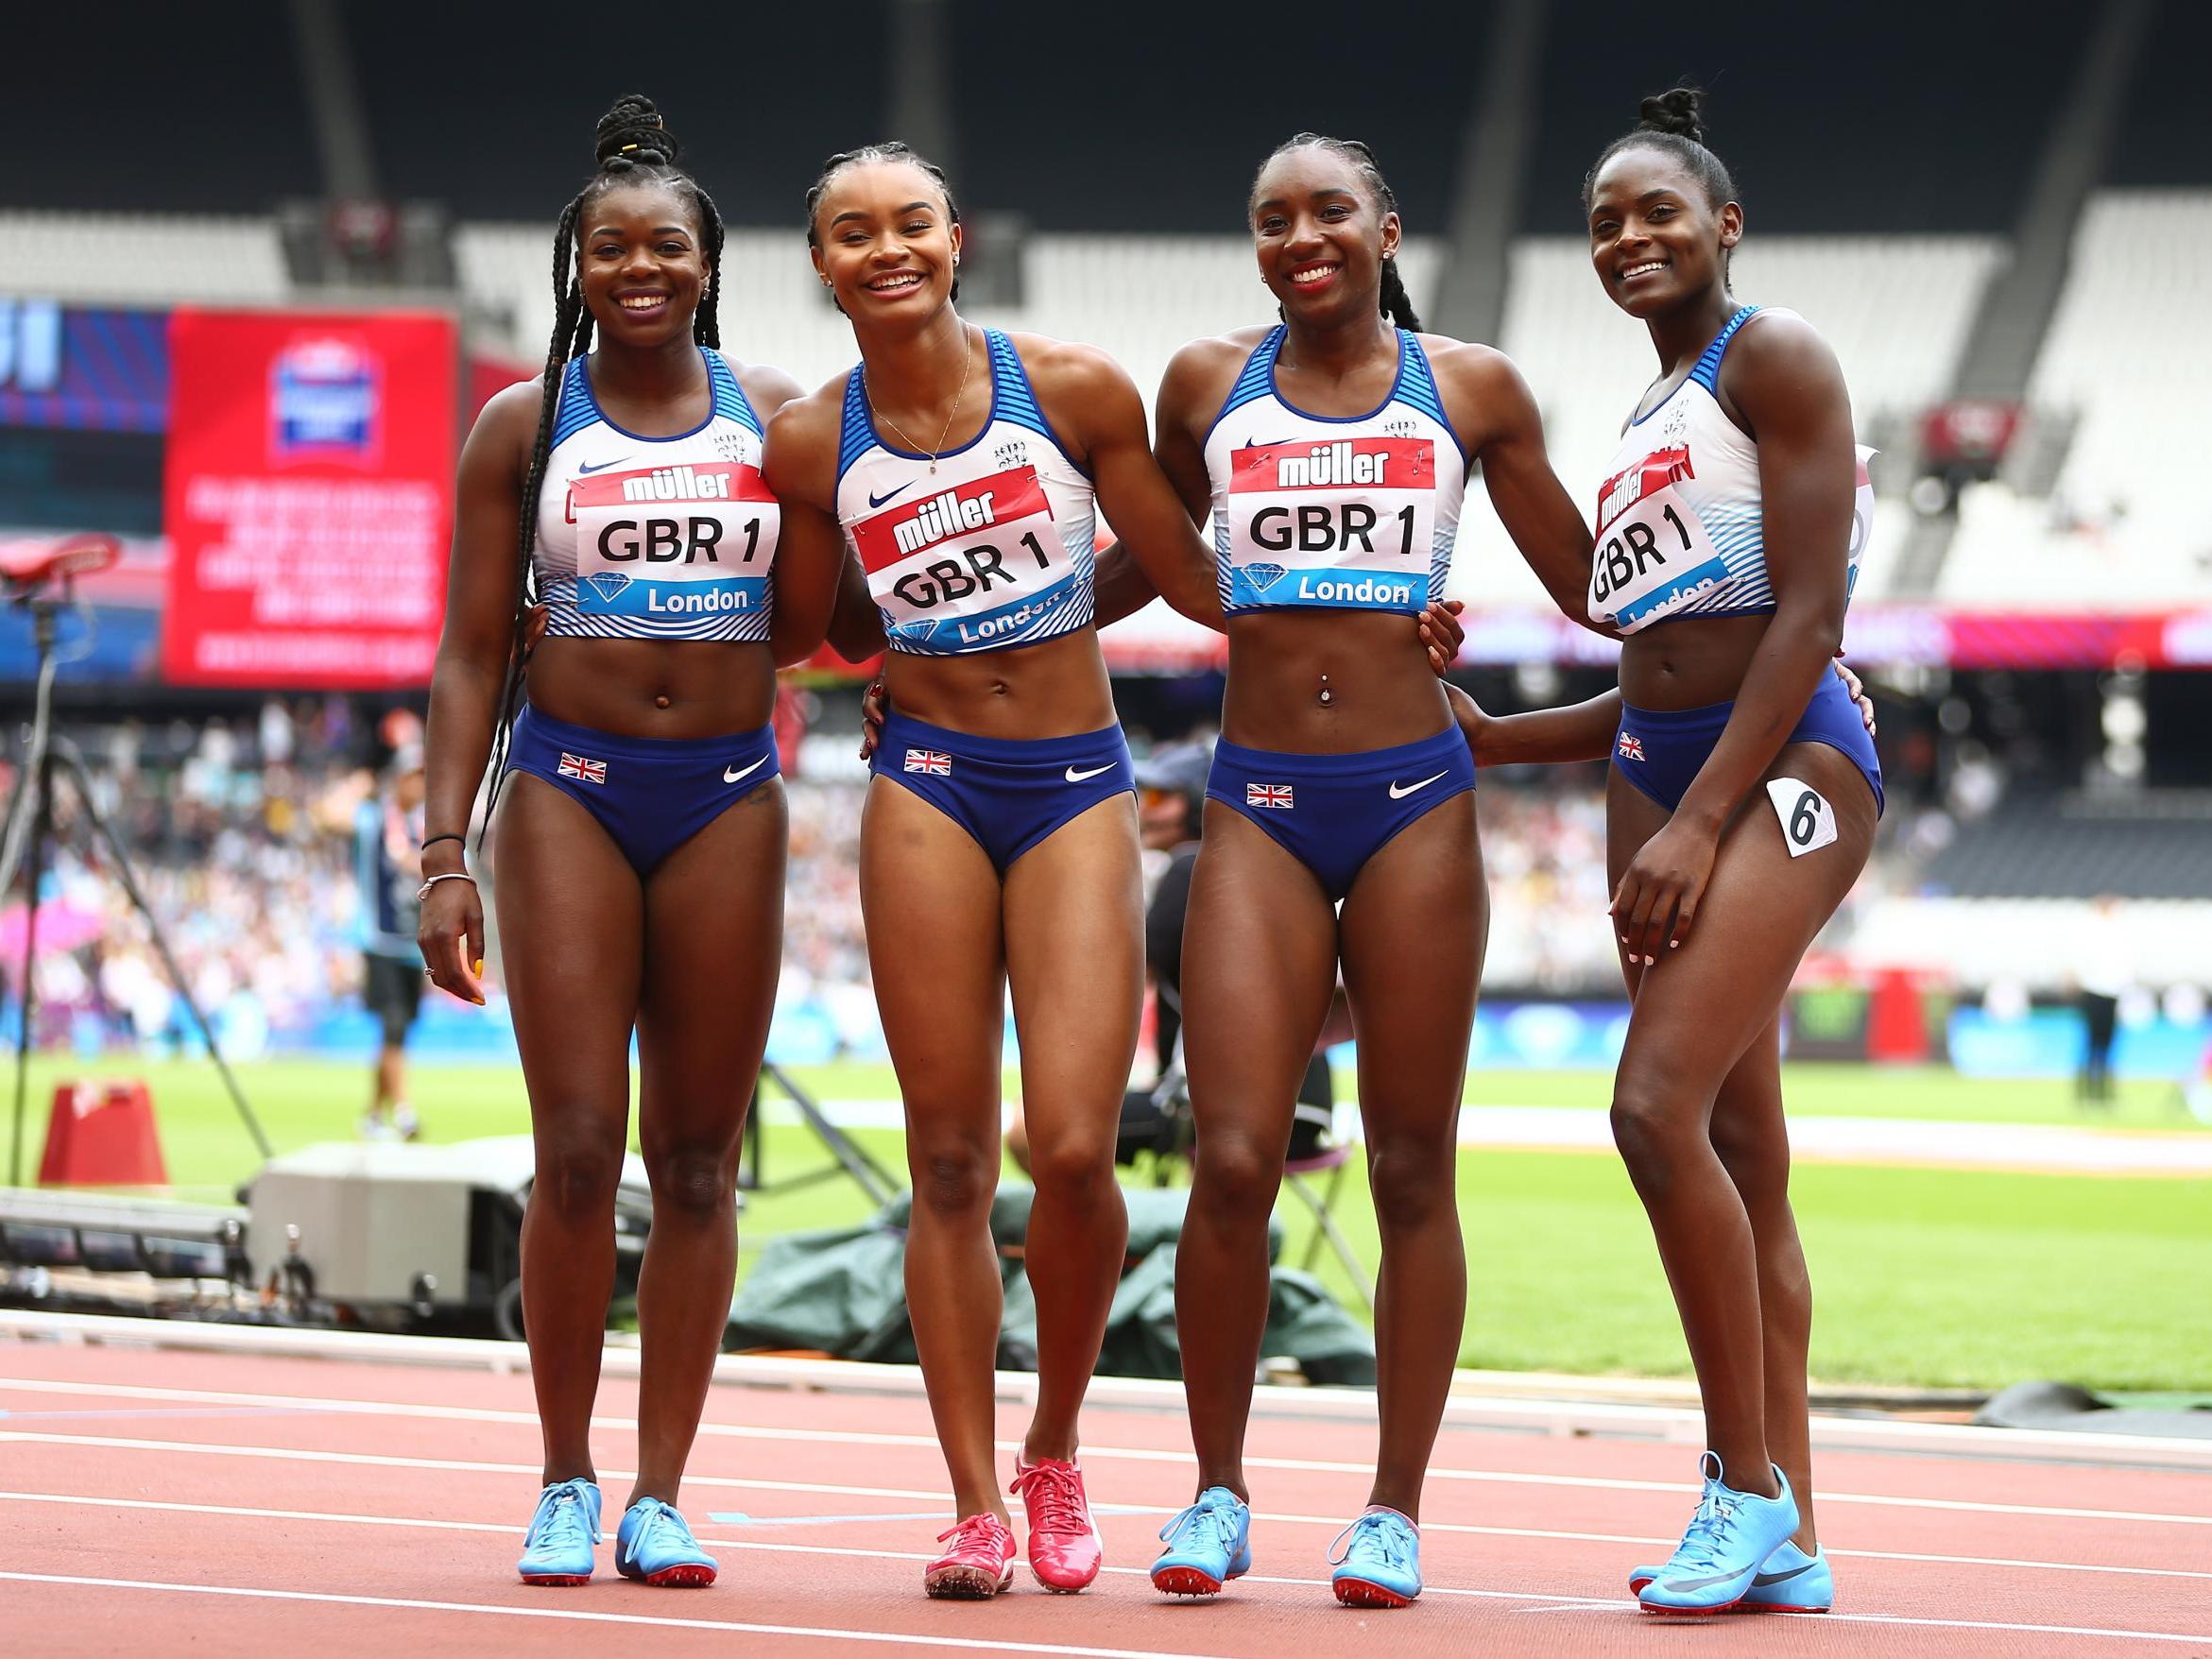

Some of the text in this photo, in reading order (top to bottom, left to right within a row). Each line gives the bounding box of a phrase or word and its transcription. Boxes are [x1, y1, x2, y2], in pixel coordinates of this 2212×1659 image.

[622, 467, 730, 502] müller
[1277, 441, 1390, 487] müller
[597, 516, 761, 564] GBR 1
[893, 490, 995, 556] müller
[1249, 504, 1415, 555] GBR 1
[893, 531, 1051, 608] GBR 1
[1594, 504, 1692, 603] GBR 1
[648, 588, 747, 612] London
[1298, 575, 1411, 604] London
[958, 592, 1059, 643] London
[1790, 790, 1822, 846] 6
